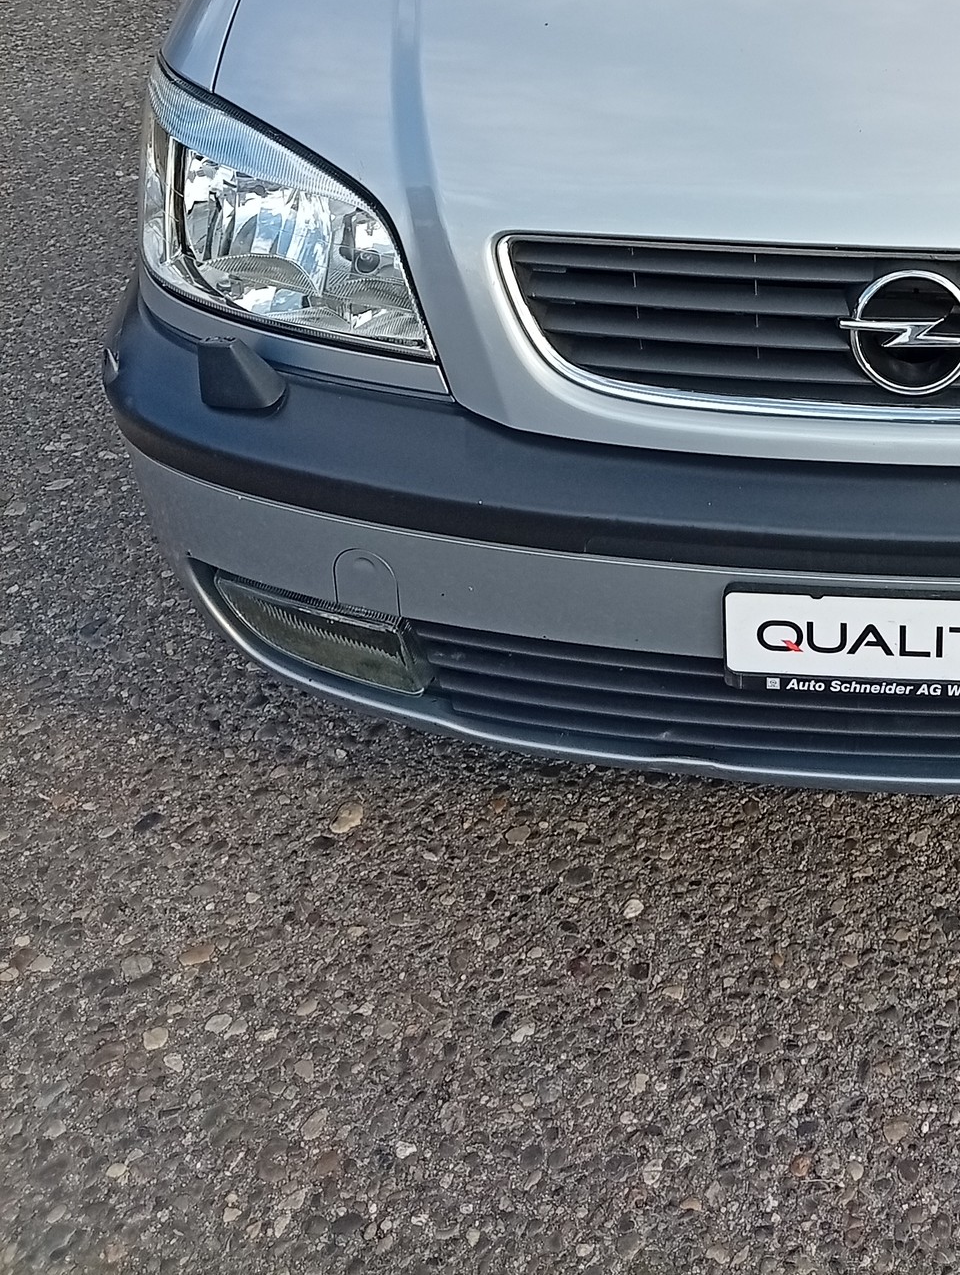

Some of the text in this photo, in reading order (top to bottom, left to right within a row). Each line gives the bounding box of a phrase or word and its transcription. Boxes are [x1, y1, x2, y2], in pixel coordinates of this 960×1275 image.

[786, 678, 825, 691] Auto
[829, 680, 914, 695] Schneider
[916, 684, 942, 696] AG
